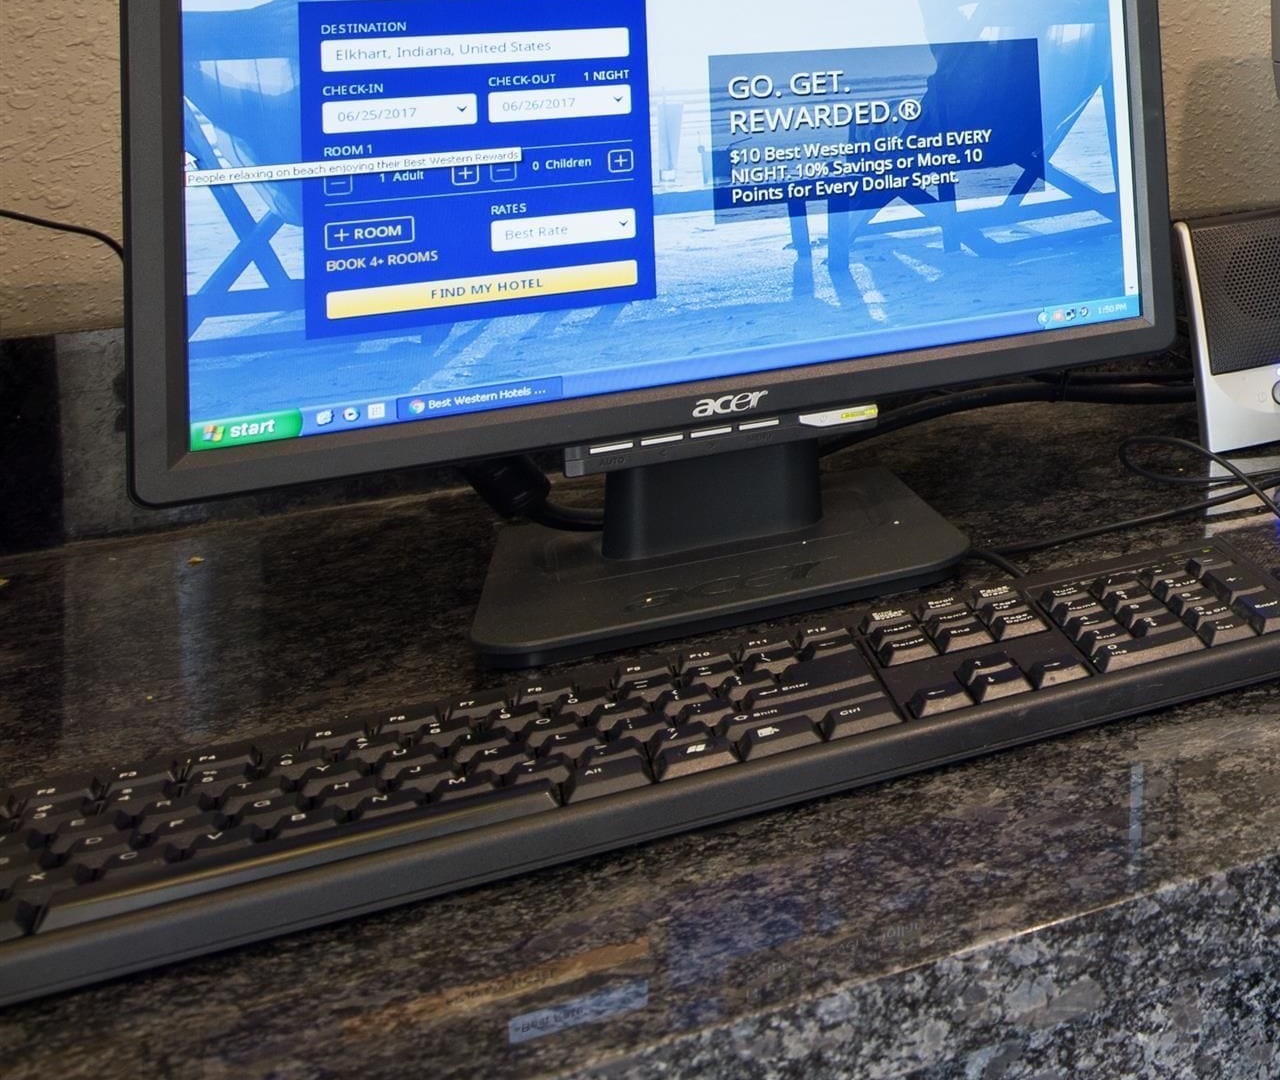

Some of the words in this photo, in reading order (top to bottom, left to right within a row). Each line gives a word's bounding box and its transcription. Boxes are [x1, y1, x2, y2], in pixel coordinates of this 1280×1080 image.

[321, 22, 407, 35] DESTINATION
[336, 48, 391, 62] Elkhart,
[397, 45, 455, 59] Indiana,
[459, 42, 507, 55] United
[511, 40, 552, 53] States
[488, 74, 556, 87] CHECK-OUT
[583, 72, 588, 81] 1
[592, 70, 629, 81] NIGHT
[322, 83, 384, 97] CHECK-IN
[728, 75, 781, 99] GO.
[790, 71, 850, 94] GET.
[502, 97, 576, 112] 06/26/2017
[337, 107, 417, 122] 06/25/2017
[324, 145, 365, 157] ROOM
[369, 144, 373, 155] 1
[730, 148, 761, 165] $10
[765, 145, 801, 162] Best
[804, 140, 871, 159] Western
[874, 138, 903, 153] Gift
[906, 135, 942, 150] Card
[947, 129, 992, 145] EVERY
[188, 173, 225, 183] People
[229, 169, 273, 180] relaxing
[294, 165, 326, 176] beach
[329, 163, 374, 175] enjoying
[377, 160, 401, 170] their
[404, 159, 426, 167] Best
[430, 154, 473, 165] Western
[476, 151, 519, 161] Rewards
[532, 161, 539, 171] 0
[546, 158, 592, 170] Children
[731, 165, 793, 184] NIGHT.
[797, 162, 829, 178] 10%
[833, 157, 893, 177] Savings
[897, 156, 915, 169] or
[918, 152, 961, 167] More.
[965, 148, 983, 162] 10
[380, 173, 385, 182] 1
[393, 171, 424, 182] Adult
[732, 186, 783, 203] Points
[788, 182, 810, 197] for
[816, 180, 857, 199] Every
[863, 175, 908, 191] Dollar
[912, 171, 959, 188] Spent.
[491, 203, 527, 215] RATES
[355, 225, 402, 241] ROOM
[505, 228, 534, 241] Best
[538, 224, 569, 239] Rate
[327, 257, 366, 272] BOOK
[370, 255, 384, 269] 4+
[388, 251, 438, 266] ROOMS
[431, 286, 466, 299] FIND
[471, 283, 494, 294] MY
[498, 279, 543, 291] HOTEL
[428, 398, 452, 409] Best
[455, 392, 497, 405] Western
[500, 386, 532, 399] Hotels
[692, 390, 768, 418] acer
[230, 419, 275, 438] start
[782, 681, 809, 691] Enter
[753, 708, 778, 717] Shift
[839, 707, 861, 716] Ctrl
[585, 768, 602, 776] Alt
